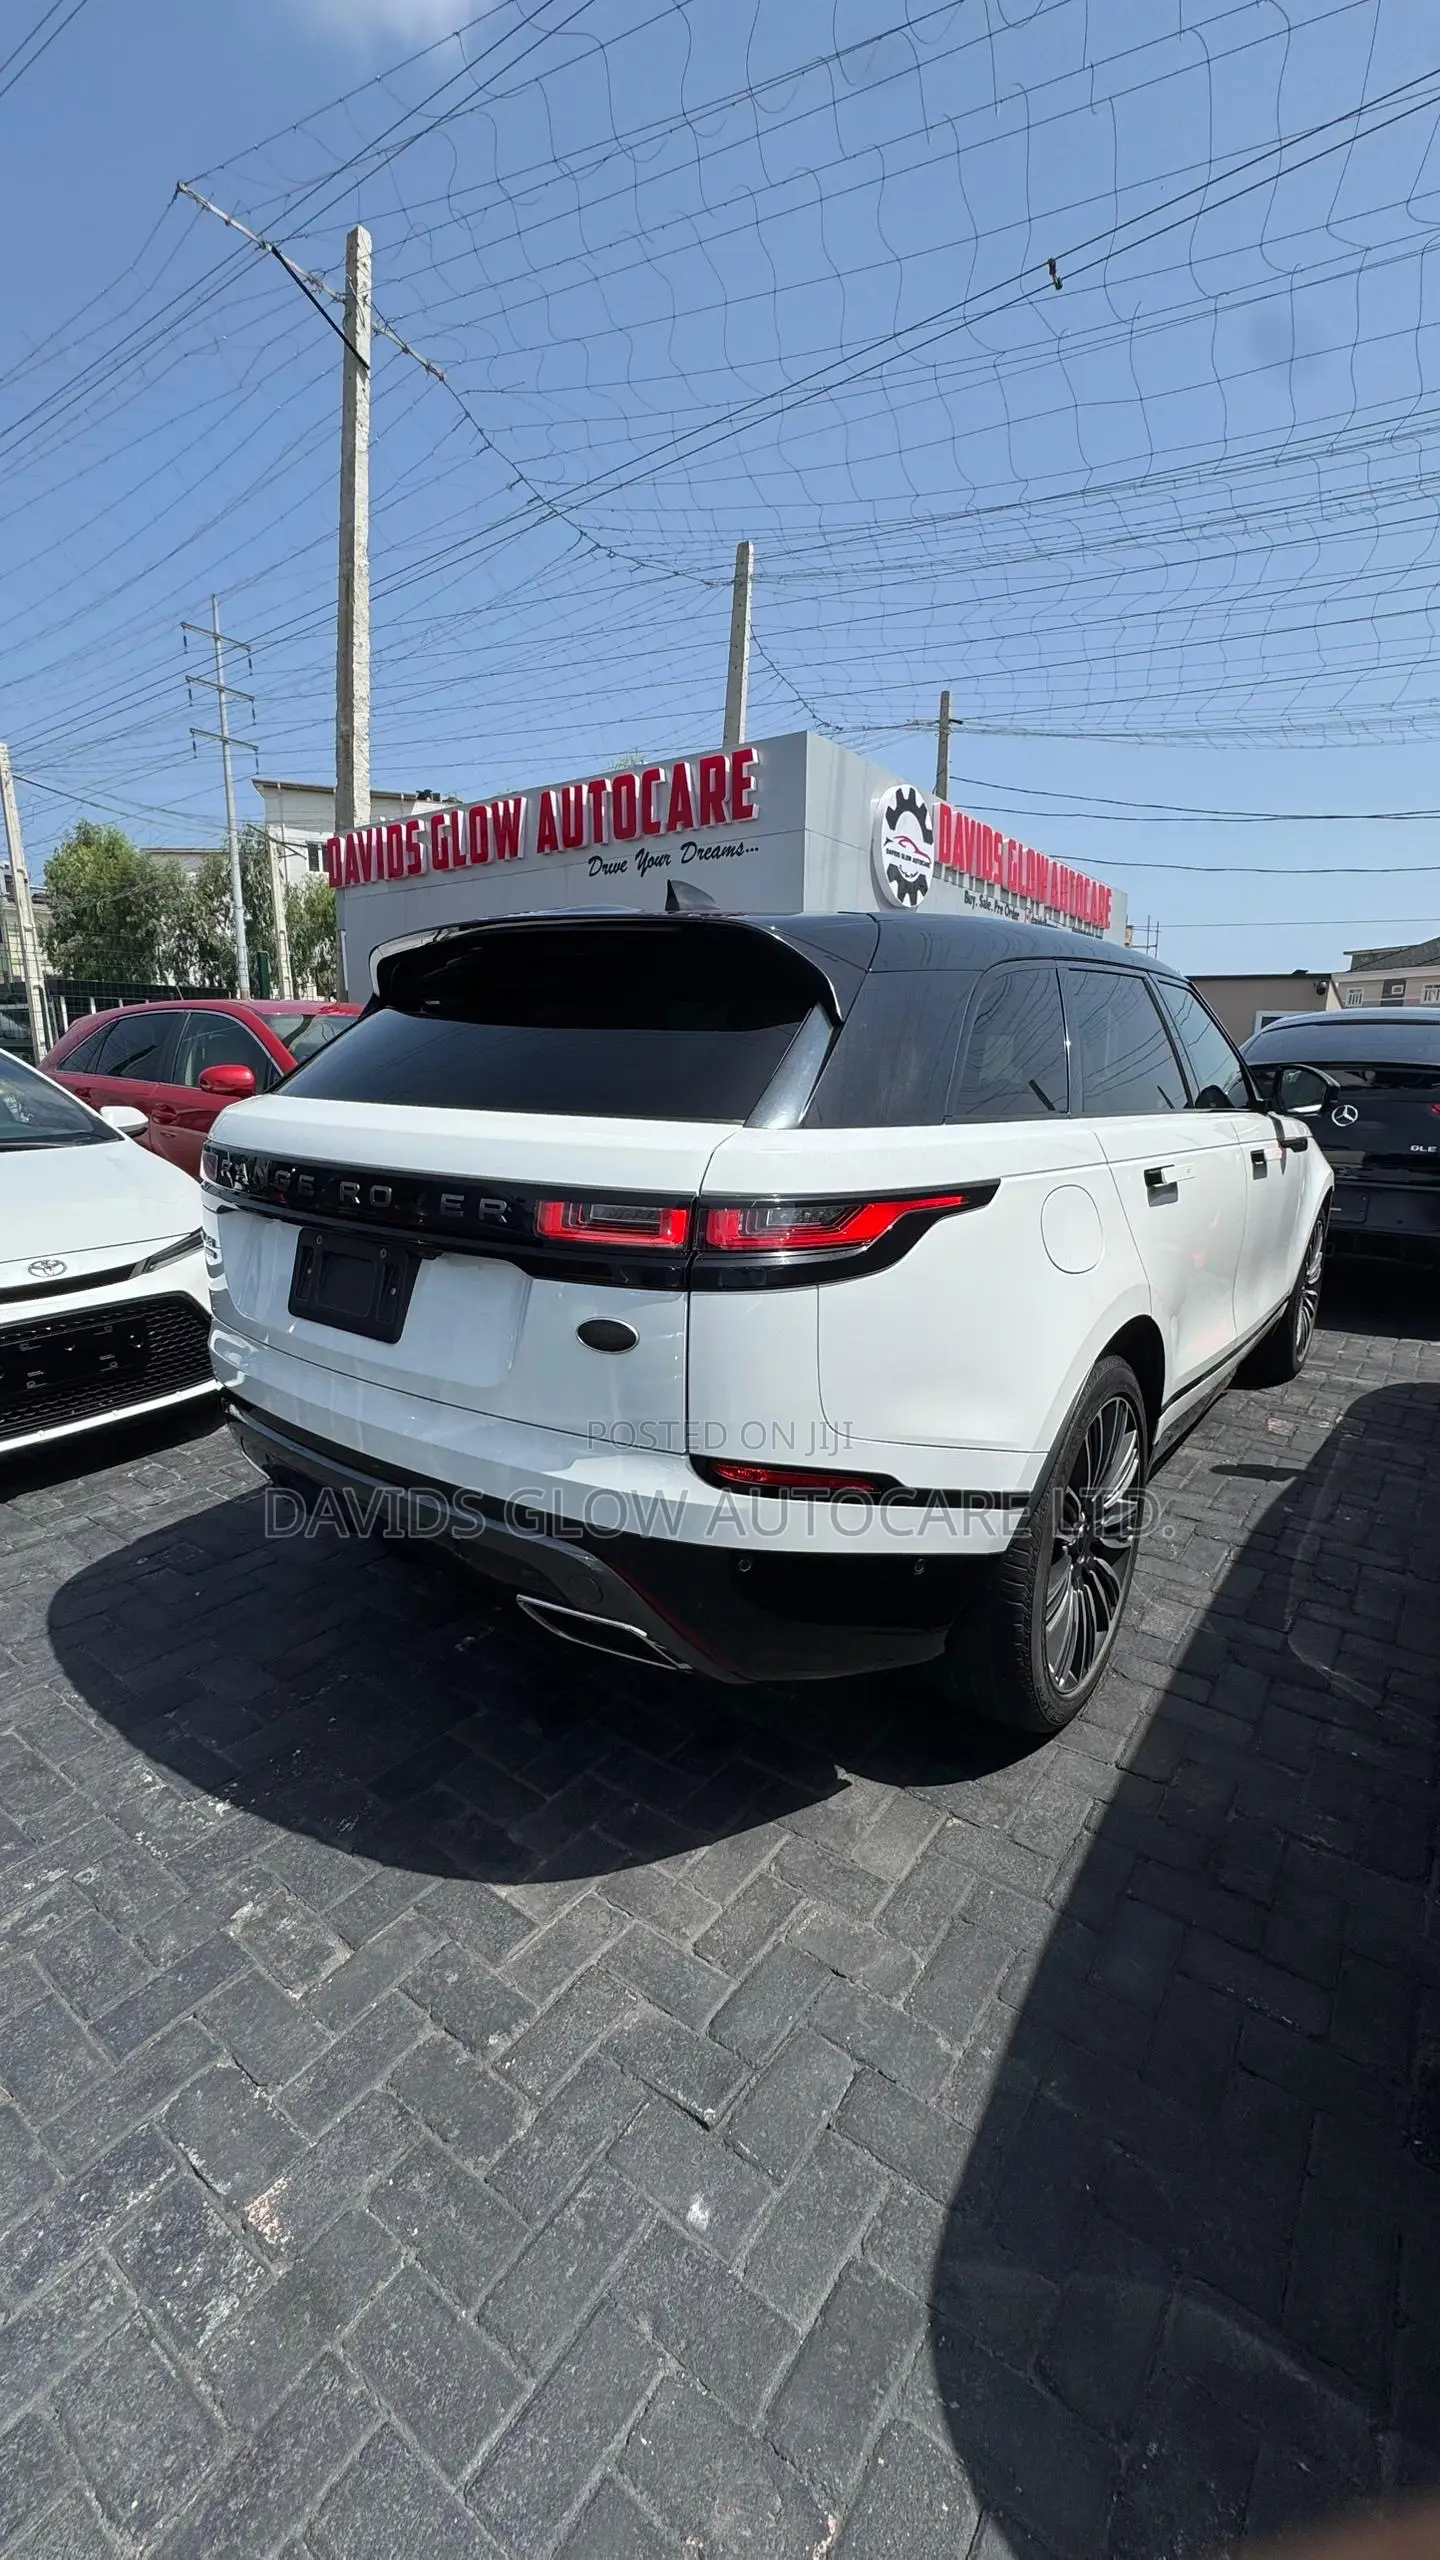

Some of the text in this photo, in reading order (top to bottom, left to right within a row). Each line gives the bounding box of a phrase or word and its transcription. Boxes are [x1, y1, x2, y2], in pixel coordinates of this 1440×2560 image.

[327, 747, 761, 889] DAVIDS GLOW AUTOCARE
[635, 848, 671, 878] Your
[680, 840, 760, 865] Dreams...
[937, 802, 1112, 929] DAVIDS GLOW AUTOCARE
[339, 1180, 508, 1224] ROER
